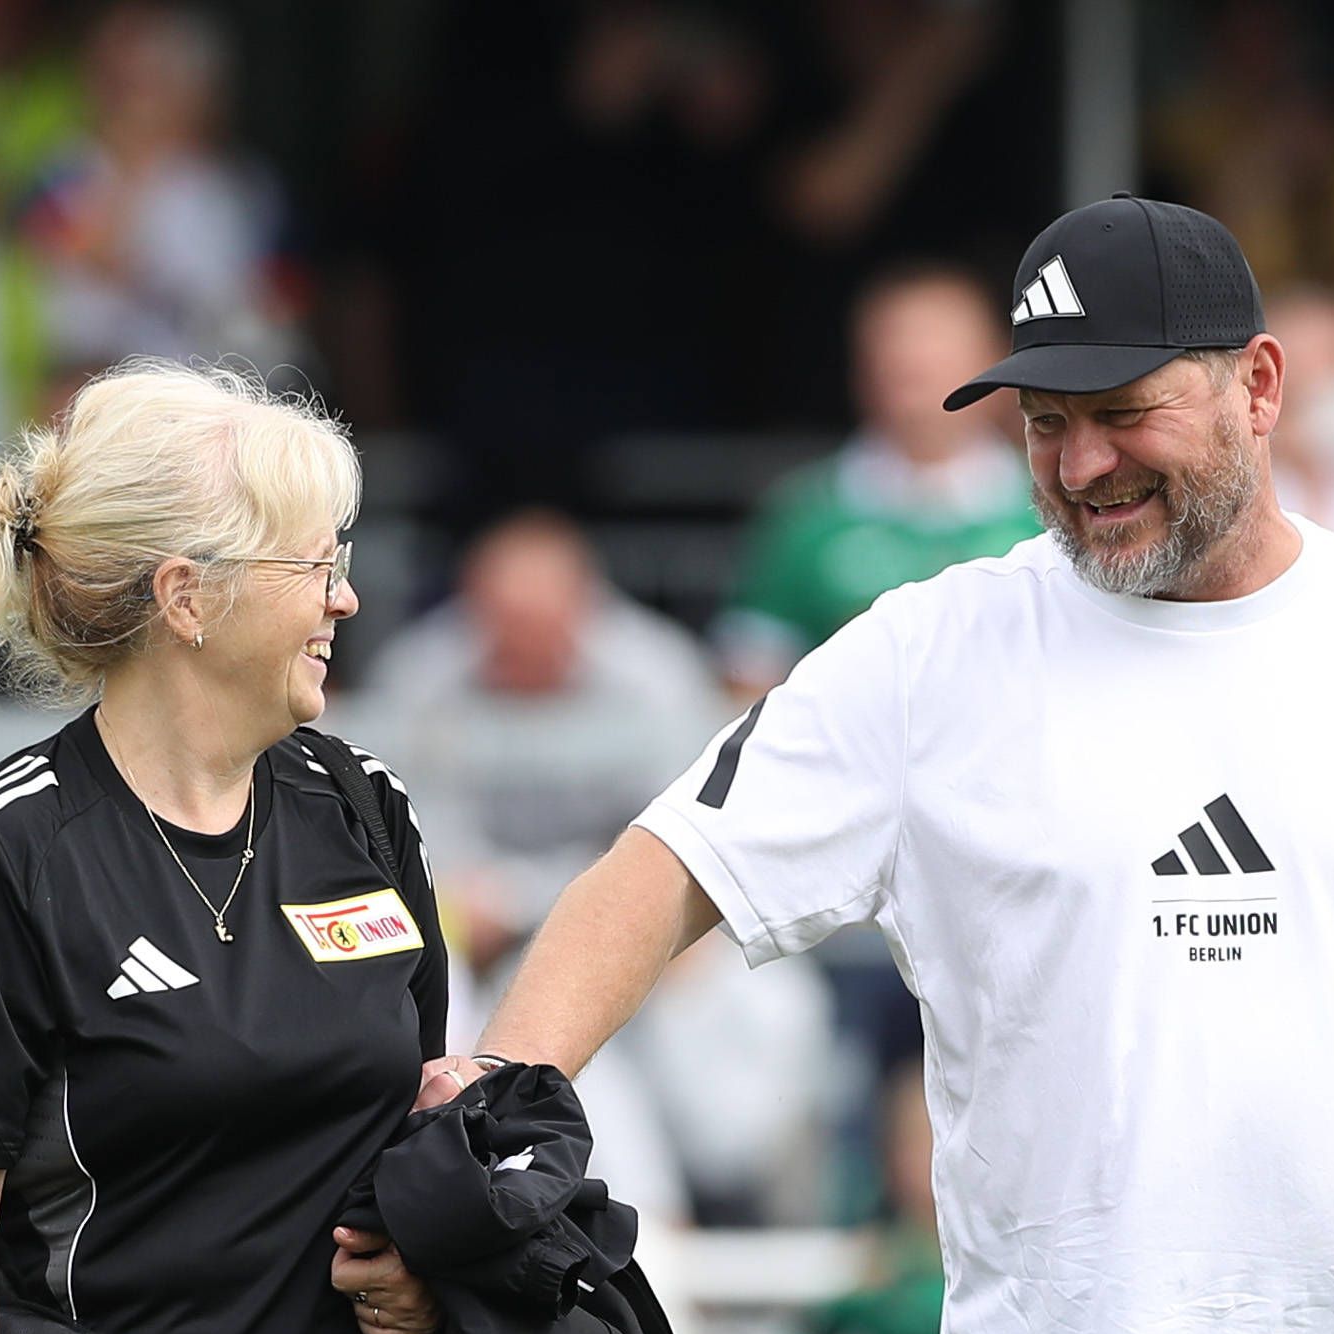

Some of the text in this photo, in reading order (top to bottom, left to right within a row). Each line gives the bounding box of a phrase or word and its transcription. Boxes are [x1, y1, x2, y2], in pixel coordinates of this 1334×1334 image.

[355, 915, 408, 942] UNION
[1152, 912, 1277, 937] 1. FC UNION
[1189, 946, 1242, 962] BERLIN
